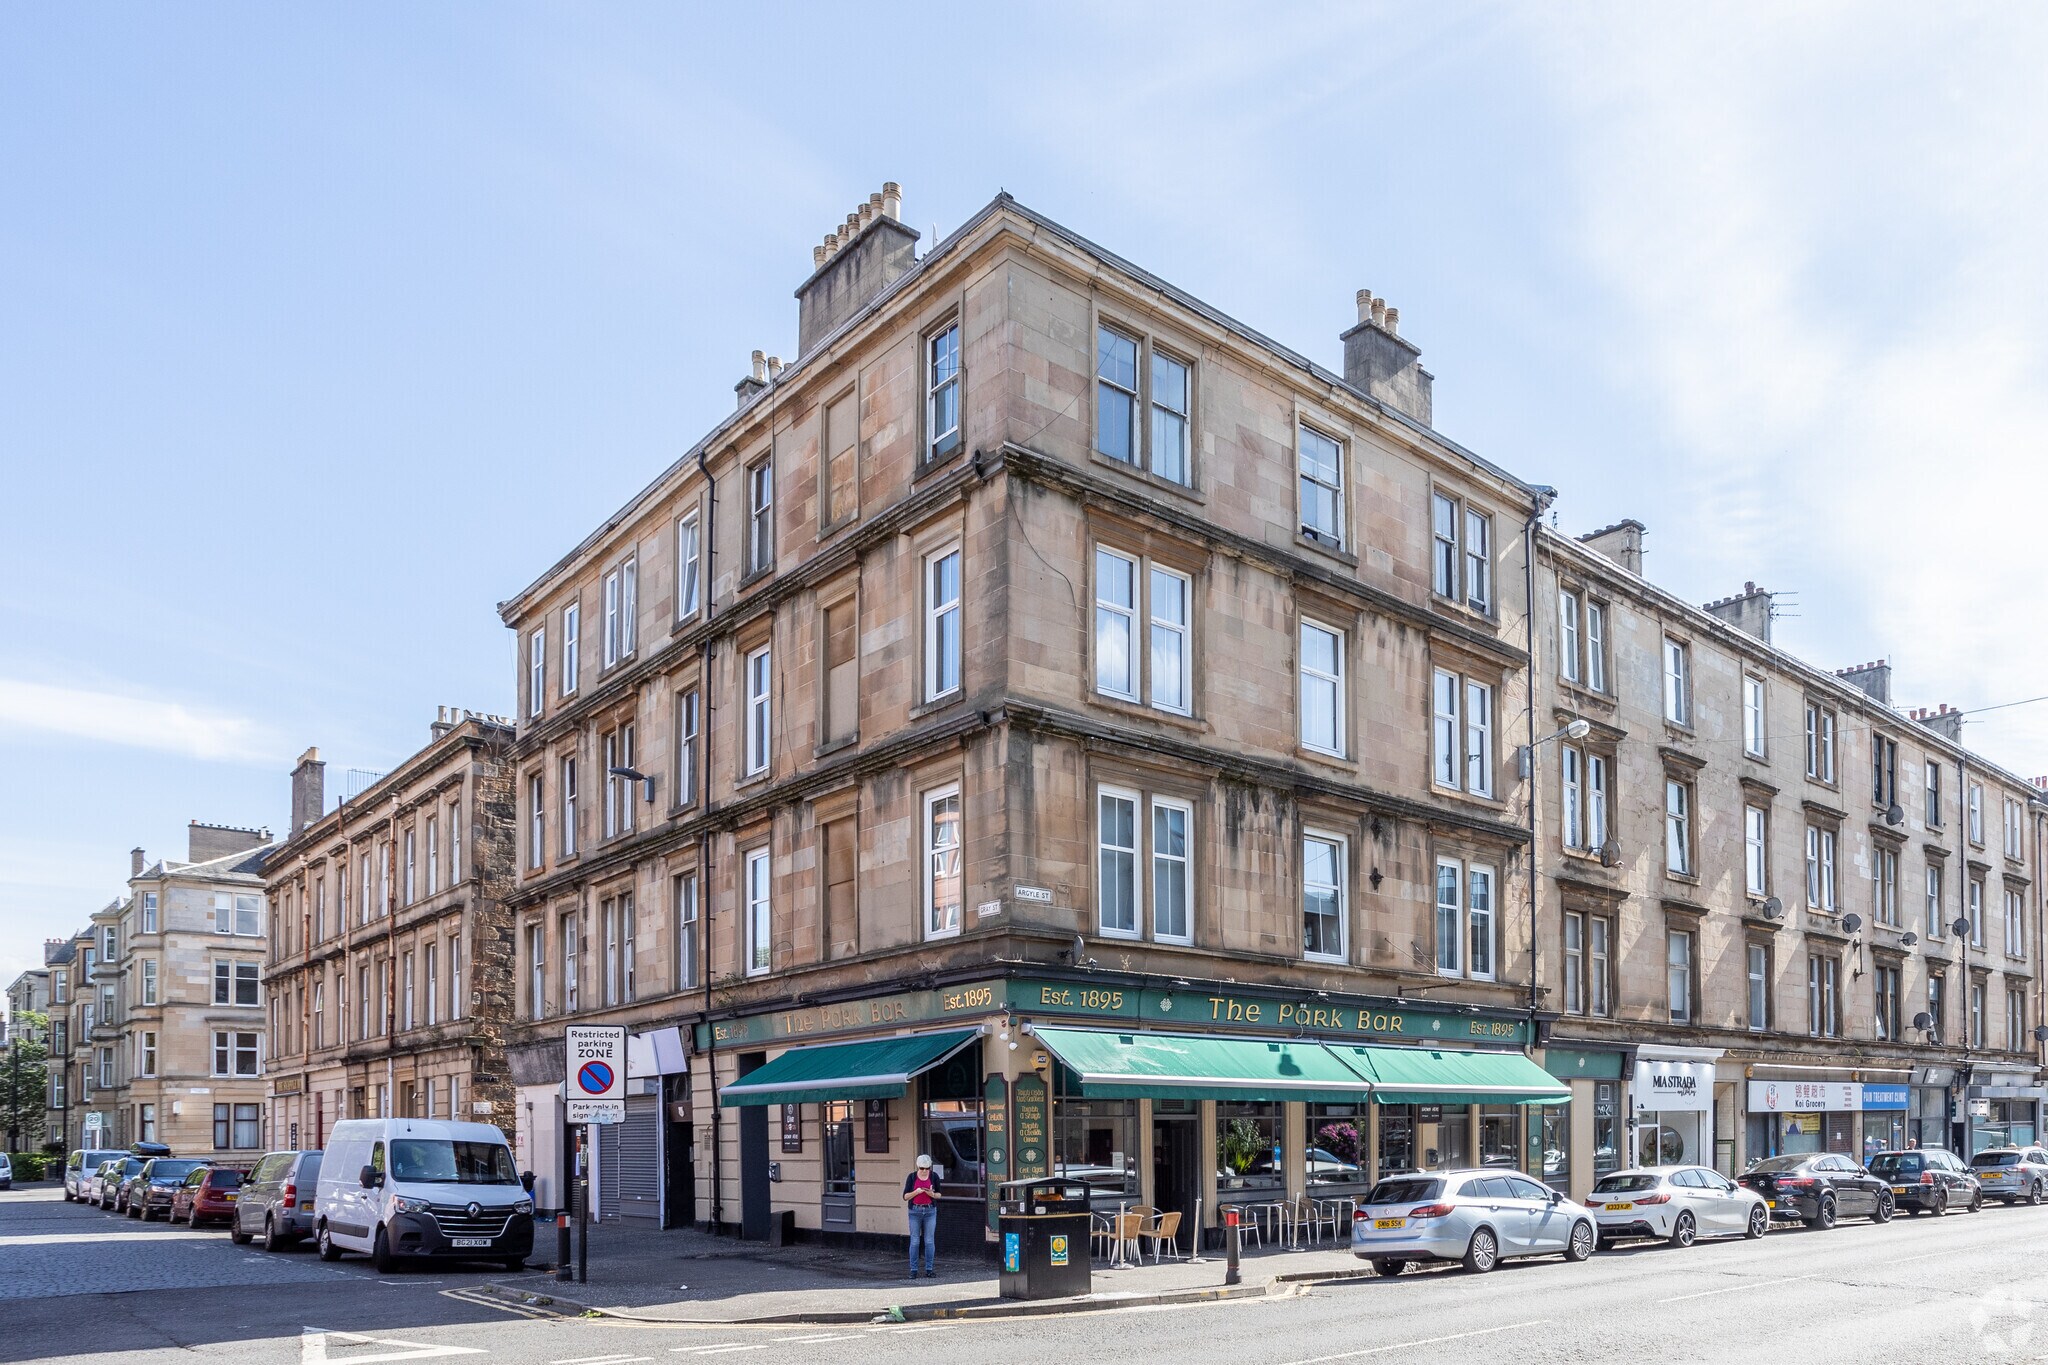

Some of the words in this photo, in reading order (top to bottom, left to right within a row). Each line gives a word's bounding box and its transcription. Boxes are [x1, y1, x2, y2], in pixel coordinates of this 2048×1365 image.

[1017, 889, 1040, 899] ARGYLE
[1041, 892, 1049, 900] ST
[980, 905, 991, 914] GRAY
[1040, 987, 1074, 1007] Est.
[1080, 990, 1123, 1010] 1895
[1209, 998, 1262, 1023] The
[571, 1030, 620, 1039] Restricted
[715, 1026, 729, 1040] Est.
[730, 1024, 748, 1039] 1895
[1470, 1021, 1489, 1035] Est.
[1491, 1022, 1514, 1037] 1895
[577, 1040, 613, 1049] parking
[578, 1049, 613, 1058] ZONE
[1652, 1075, 1667, 1088] MIA
[1668, 1075, 1696, 1089] STRADA
[1863, 1091, 1873, 1103] PAIN
[1873, 1091, 1894, 1103] TREATMENT
[1894, 1091, 1907, 1103] CLINIC
[1795, 1099, 1804, 1108] Koi
[1806, 1099, 1826, 1109] Grocery
[1390, 1219, 1402, 1228] SSK
